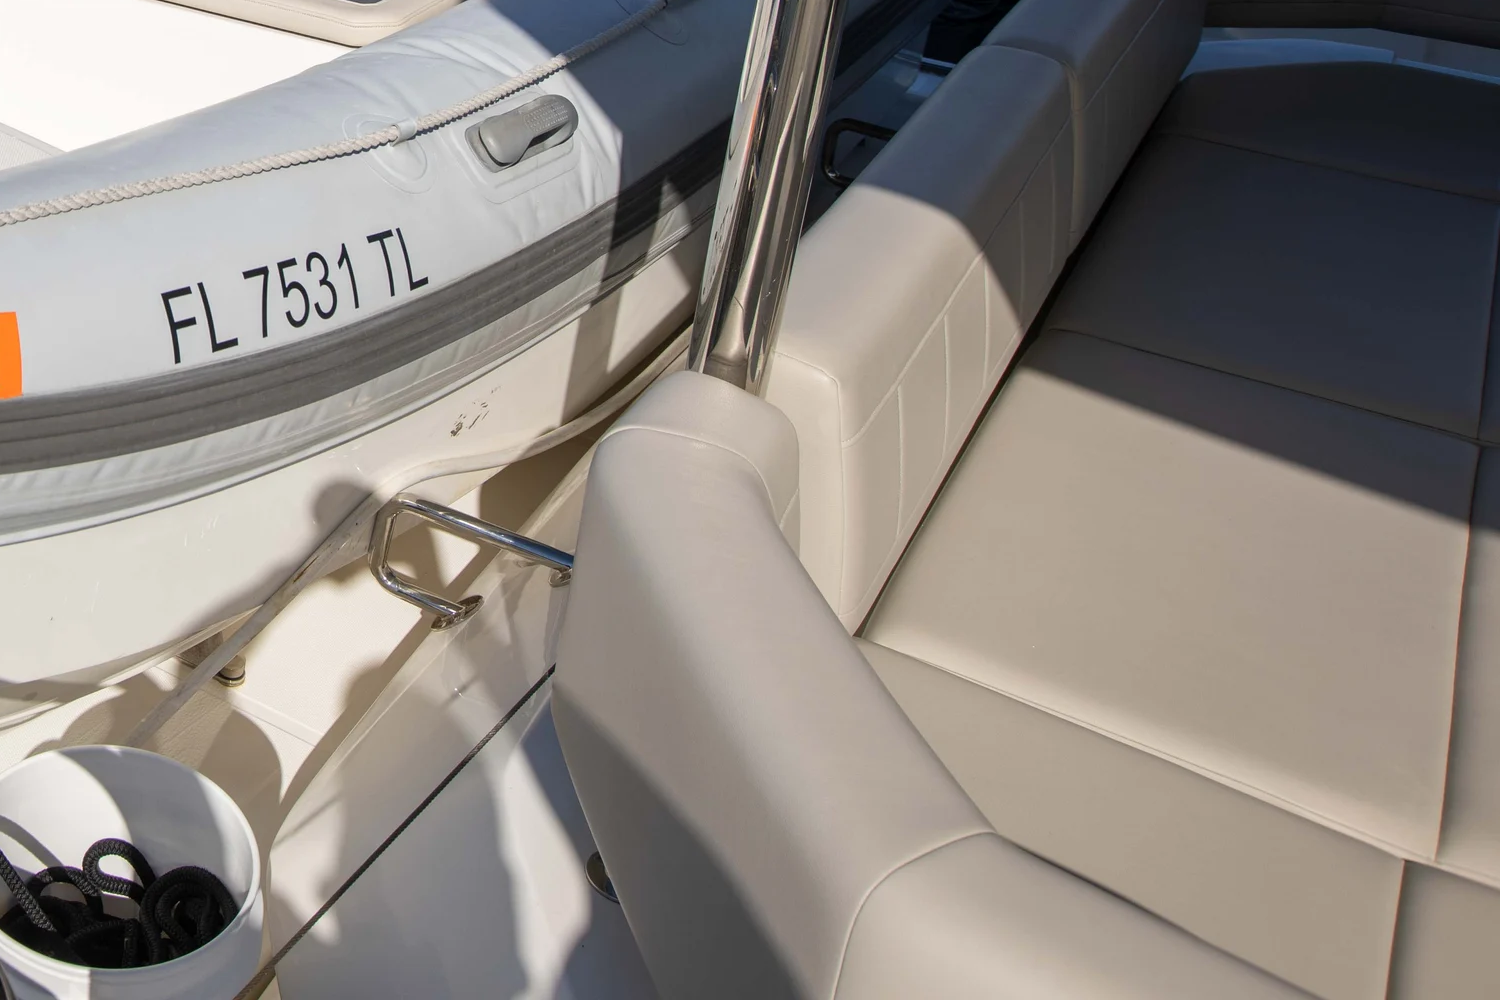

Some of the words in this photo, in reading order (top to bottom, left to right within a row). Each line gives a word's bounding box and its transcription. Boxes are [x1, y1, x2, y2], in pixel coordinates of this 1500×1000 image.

[160, 282, 239, 365] FL
[242, 242, 360, 339] 7531
[366, 227, 429, 298] TL
